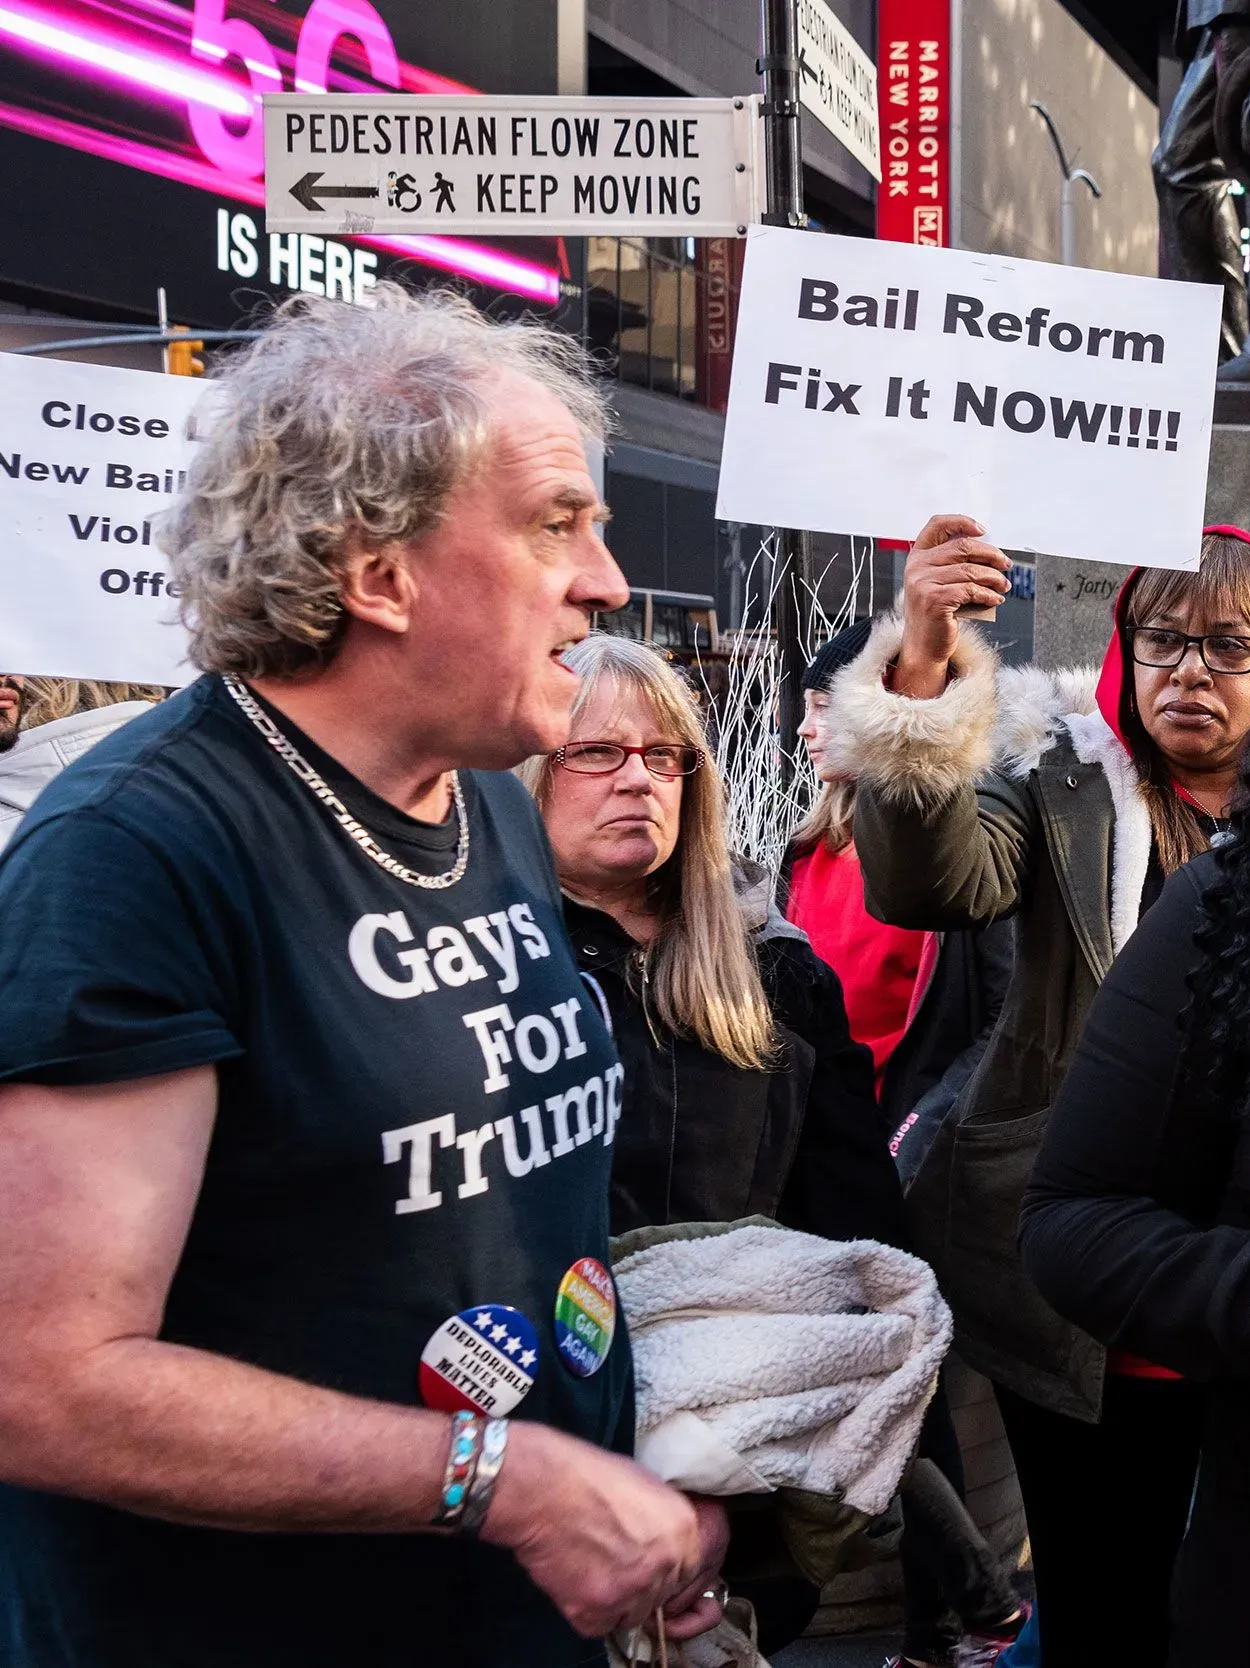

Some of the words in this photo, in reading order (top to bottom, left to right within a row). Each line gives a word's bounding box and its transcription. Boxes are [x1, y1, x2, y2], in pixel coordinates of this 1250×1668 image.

[889, 40, 910, 106] NEW
[286, 113, 497, 156] PEDESTRIAN
[511, 117, 600, 157] FLOW
[613, 118, 699, 159] ZONE
[889, 117, 910, 198] YORK
[918, 40, 939, 199] MARRIOTT
[476, 174, 558, 213] KEEP
[574, 175, 701, 216] MOVING
[217, 208, 259, 278] IS
[269, 232, 378, 309] HERE
[797, 277, 920, 331] Bail
[942, 293, 1165, 364] Reform
[41, 400, 170, 439] Close
[764, 362, 862, 416] Fix
[885, 376, 931, 420] It
[953, 381, 1181, 452] NOW!!!!
[0, 452, 90, 485] New
[105, 463, 187, 494] Bail
[348, 902, 551, 1000] Gays
[461, 997, 588, 1095] For
[381, 1061, 625, 1215] Trump
[436, 1357, 498, 1411] MATTER
[459, 1353, 499, 1389] LIVES
